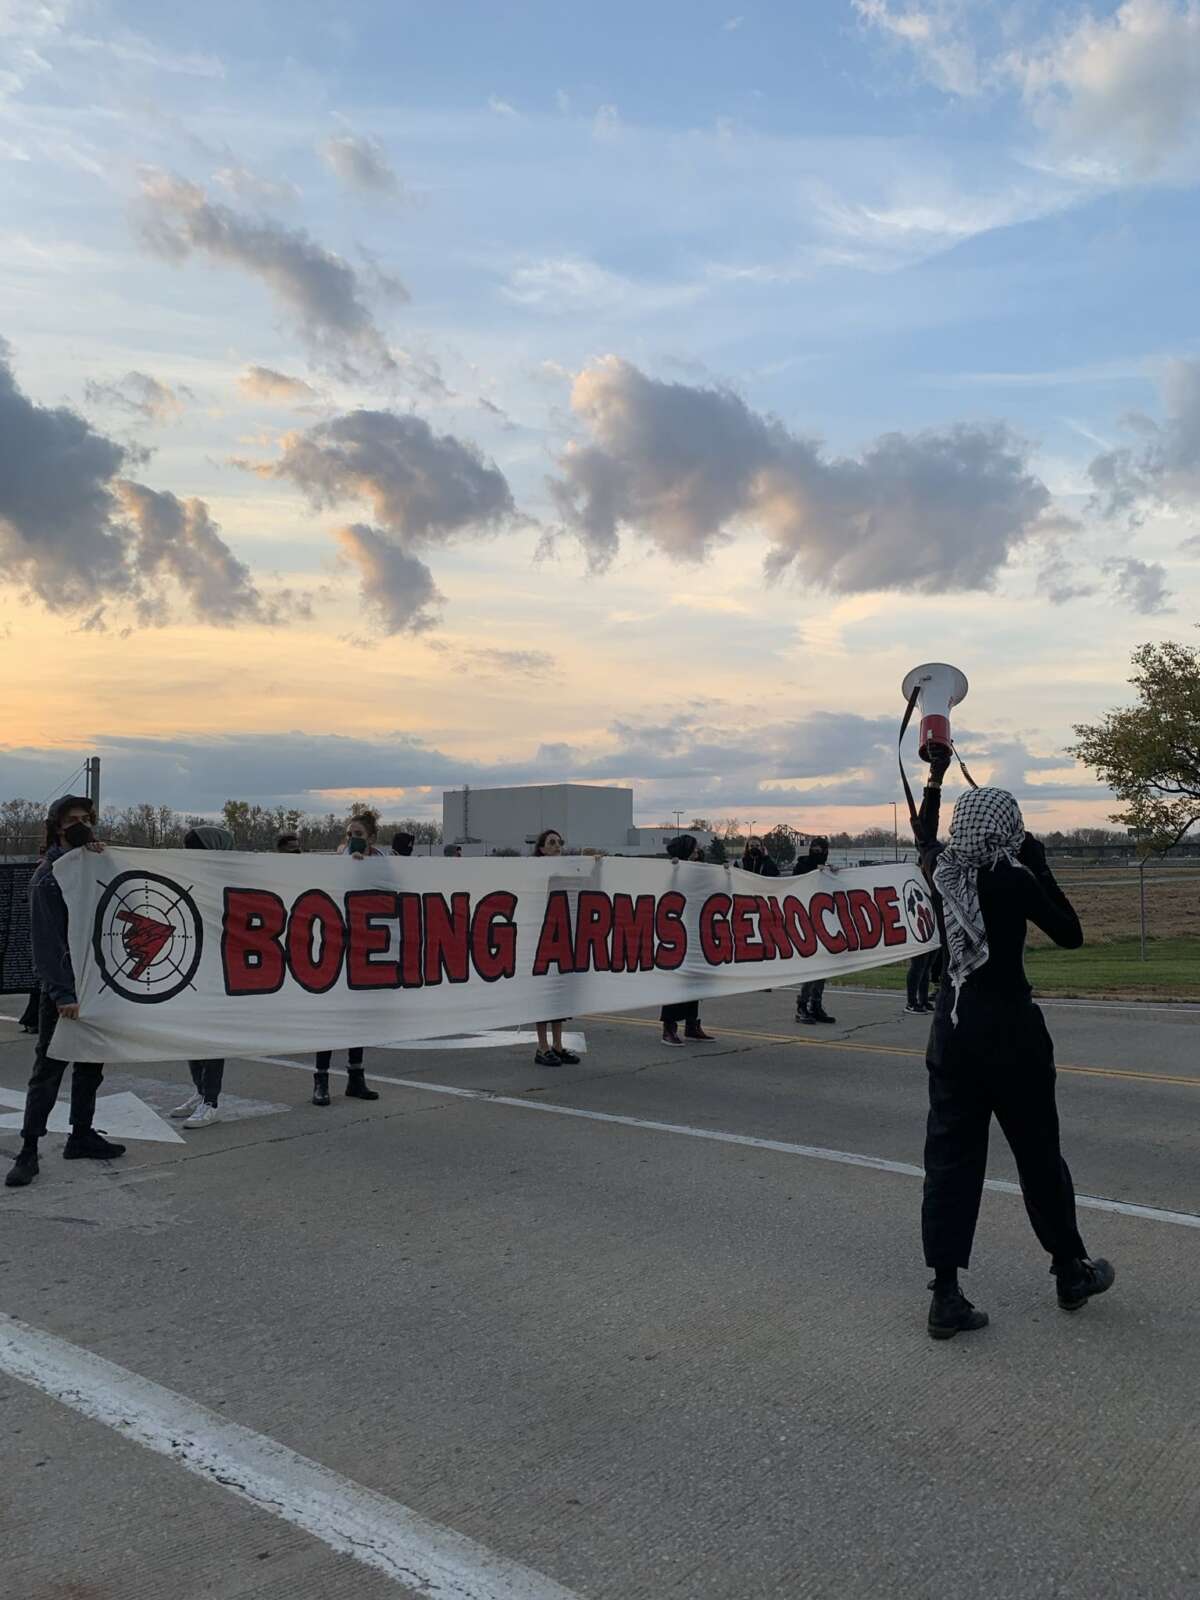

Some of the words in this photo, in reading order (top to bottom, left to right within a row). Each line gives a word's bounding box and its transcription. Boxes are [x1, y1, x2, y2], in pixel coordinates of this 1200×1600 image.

[221, 887, 518, 996] BOEING
[532, 890, 688, 976] ARMS
[700, 887, 907, 966] GENOCIDE
